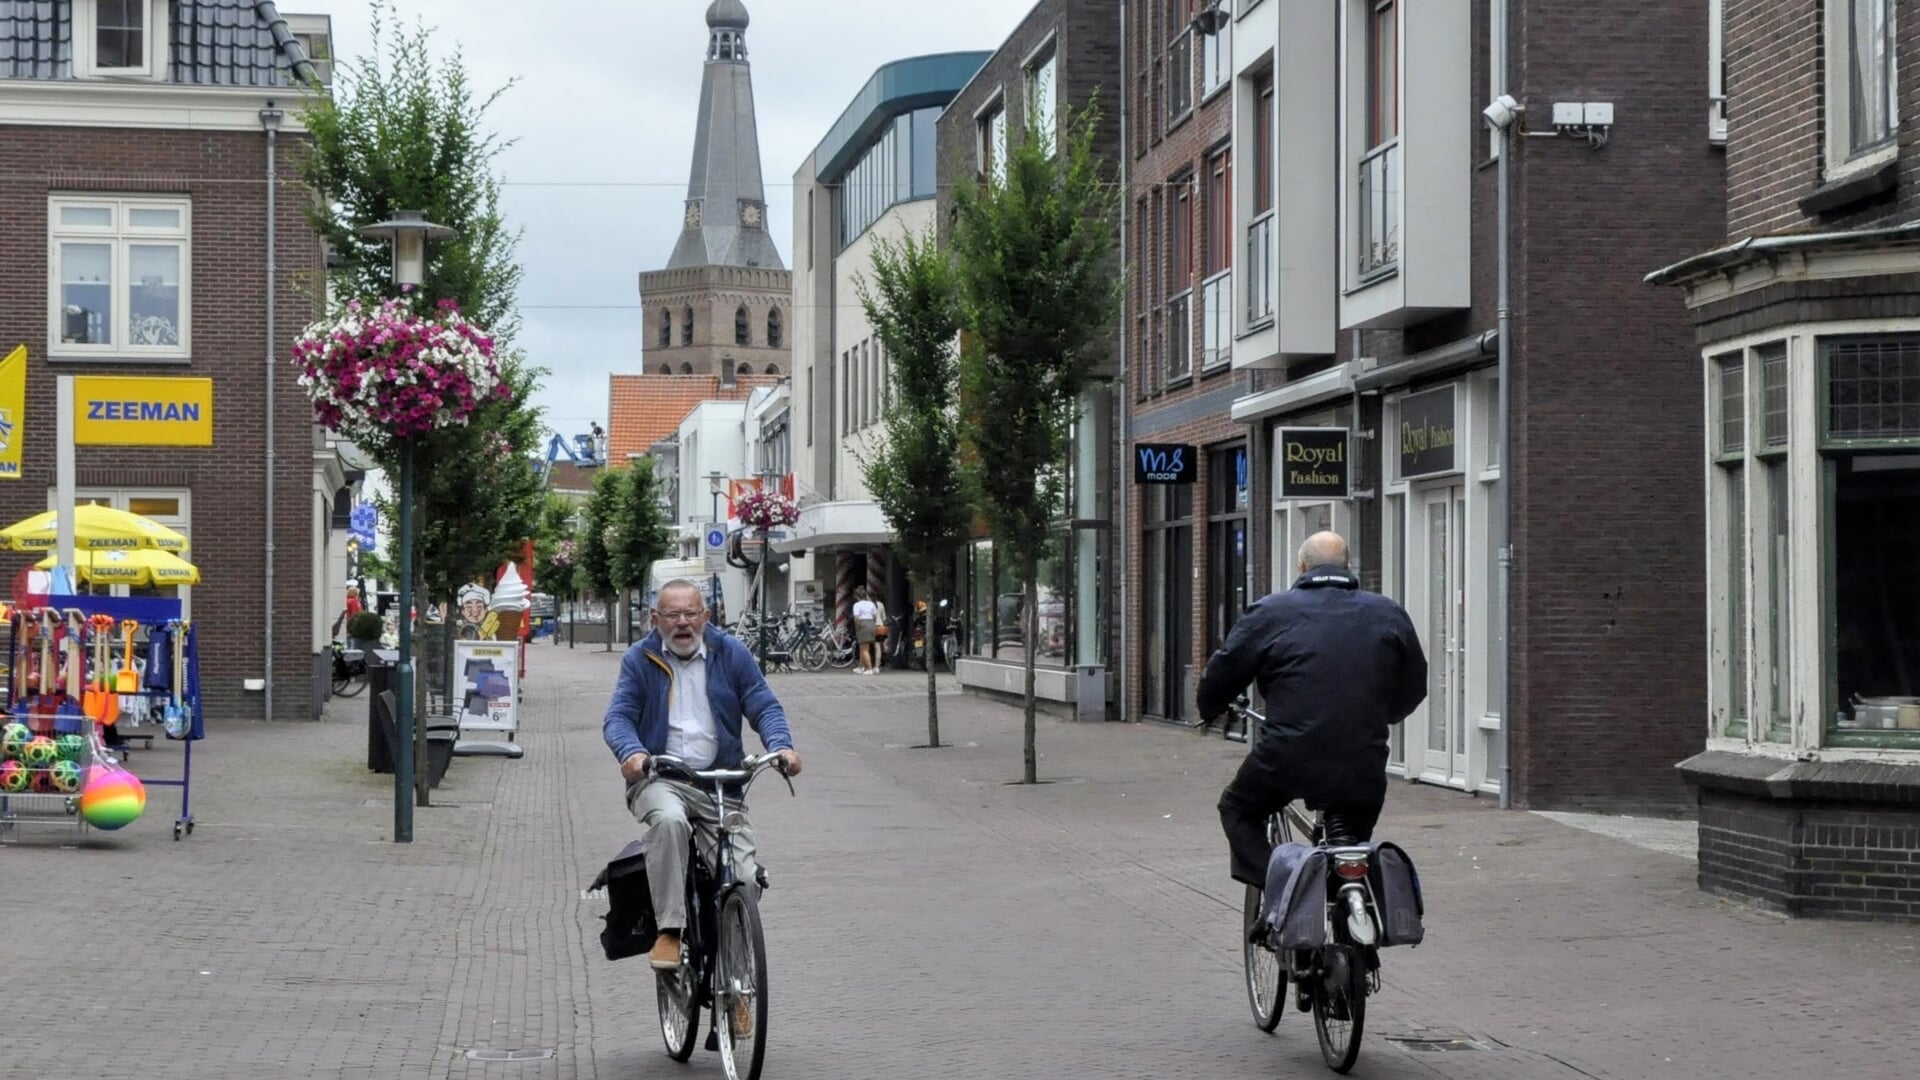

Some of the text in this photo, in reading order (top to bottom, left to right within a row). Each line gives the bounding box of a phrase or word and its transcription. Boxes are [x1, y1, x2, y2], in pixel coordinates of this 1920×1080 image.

[87, 401, 200, 421] ZEEMAN
[1286, 442, 1343, 468] Royal
[1290, 470, 1339, 485] Fashion
[22, 538, 57, 547] ZEEMA
[88, 538, 137, 547] ZEEMAN
[93, 567, 137, 576] ZEEMAN
[158, 569, 191, 577] ZEEMAN
